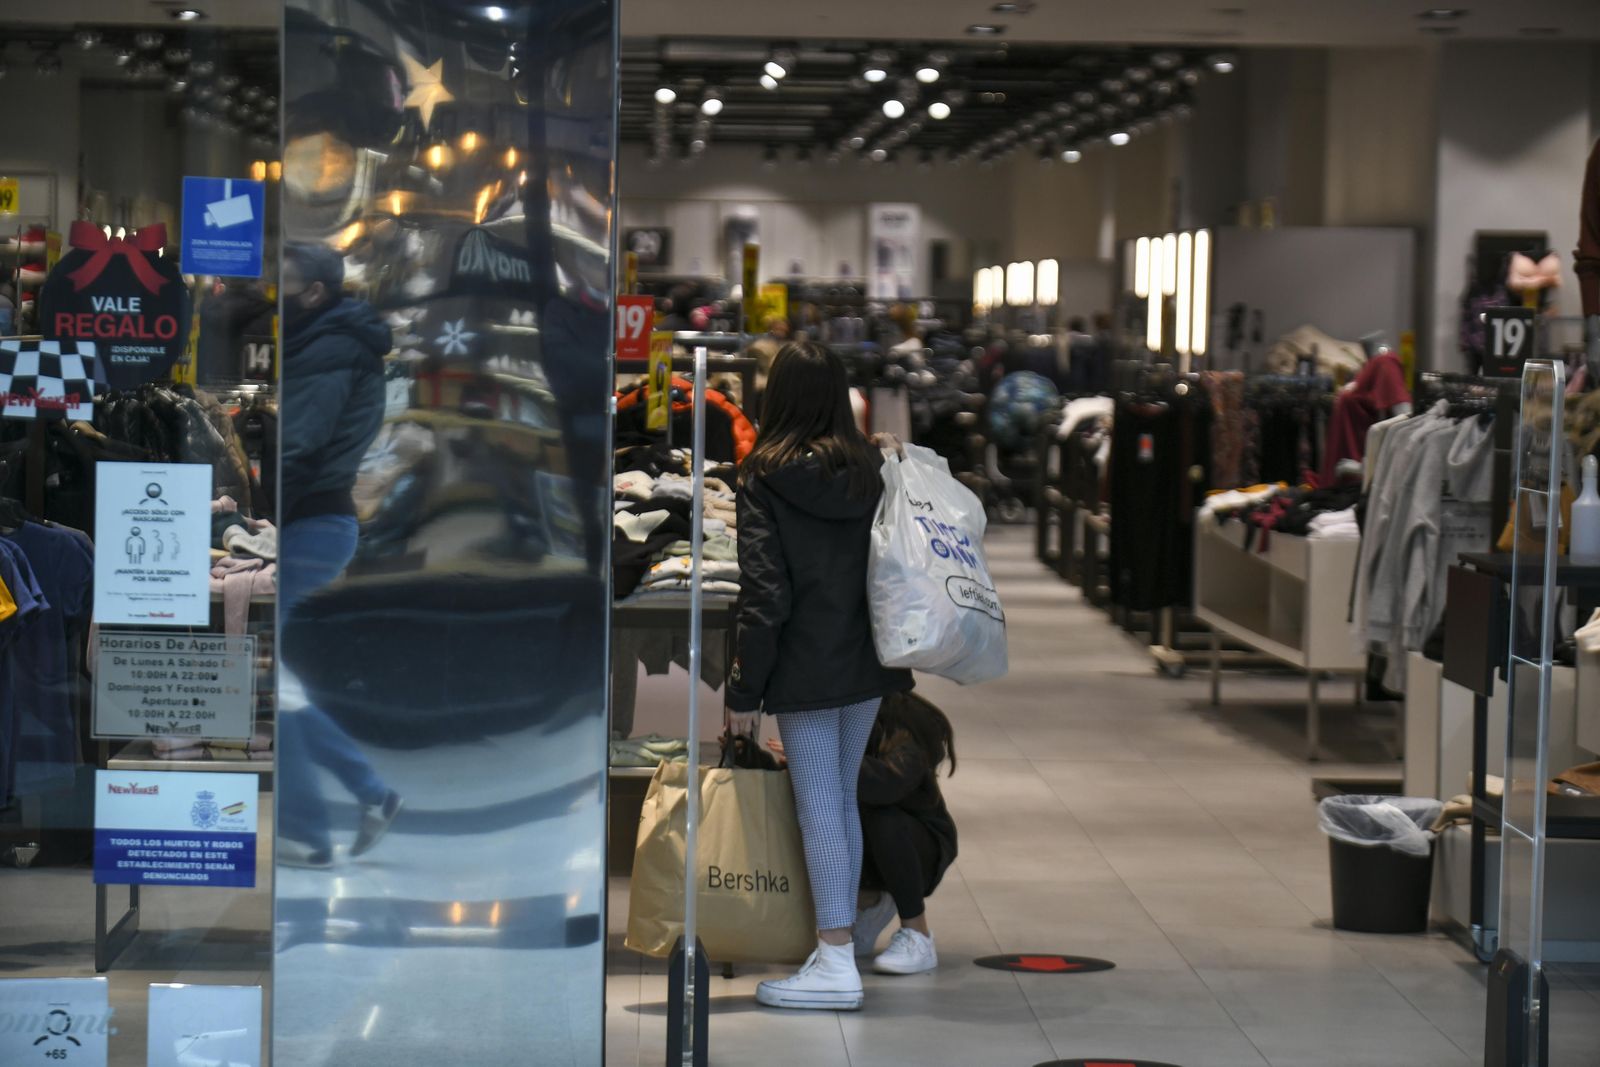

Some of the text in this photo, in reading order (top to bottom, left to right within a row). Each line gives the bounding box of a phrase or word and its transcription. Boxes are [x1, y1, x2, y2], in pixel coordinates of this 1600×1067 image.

[91, 297, 141, 312] VALE
[55, 314, 177, 339] REGALO
[617, 304, 646, 339] 19
[1491, 318, 1526, 357] 19
[247, 343, 271, 369] 14
[100, 637, 161, 650] Horarios
[166, 638, 184, 650] De
[113, 656, 127, 665] De
[131, 657, 163, 667] Lunes
[167, 658, 175, 667] A
[131, 670, 167, 679] 10:00H
[170, 671, 178, 680] A
[107, 683, 162, 694] Domingos
[166, 684, 173, 693] Y
[176, 684, 222, 694] Festivos
[141, 696, 188, 708] Apertura
[128, 708, 216, 720] 10:00H A 22:00H
[110, 838, 244, 849] TODOS LOS HURTOS Y ROBOS
[128, 850, 228, 860] DETECTADOS EN ESTE
[117, 861, 203, 870] ESTABLECIMIENTO
[143, 872, 209, 881] DENUNCIADOS
[708, 866, 790, 893] Bershka
[45, 1049, 67, 1060] +65
